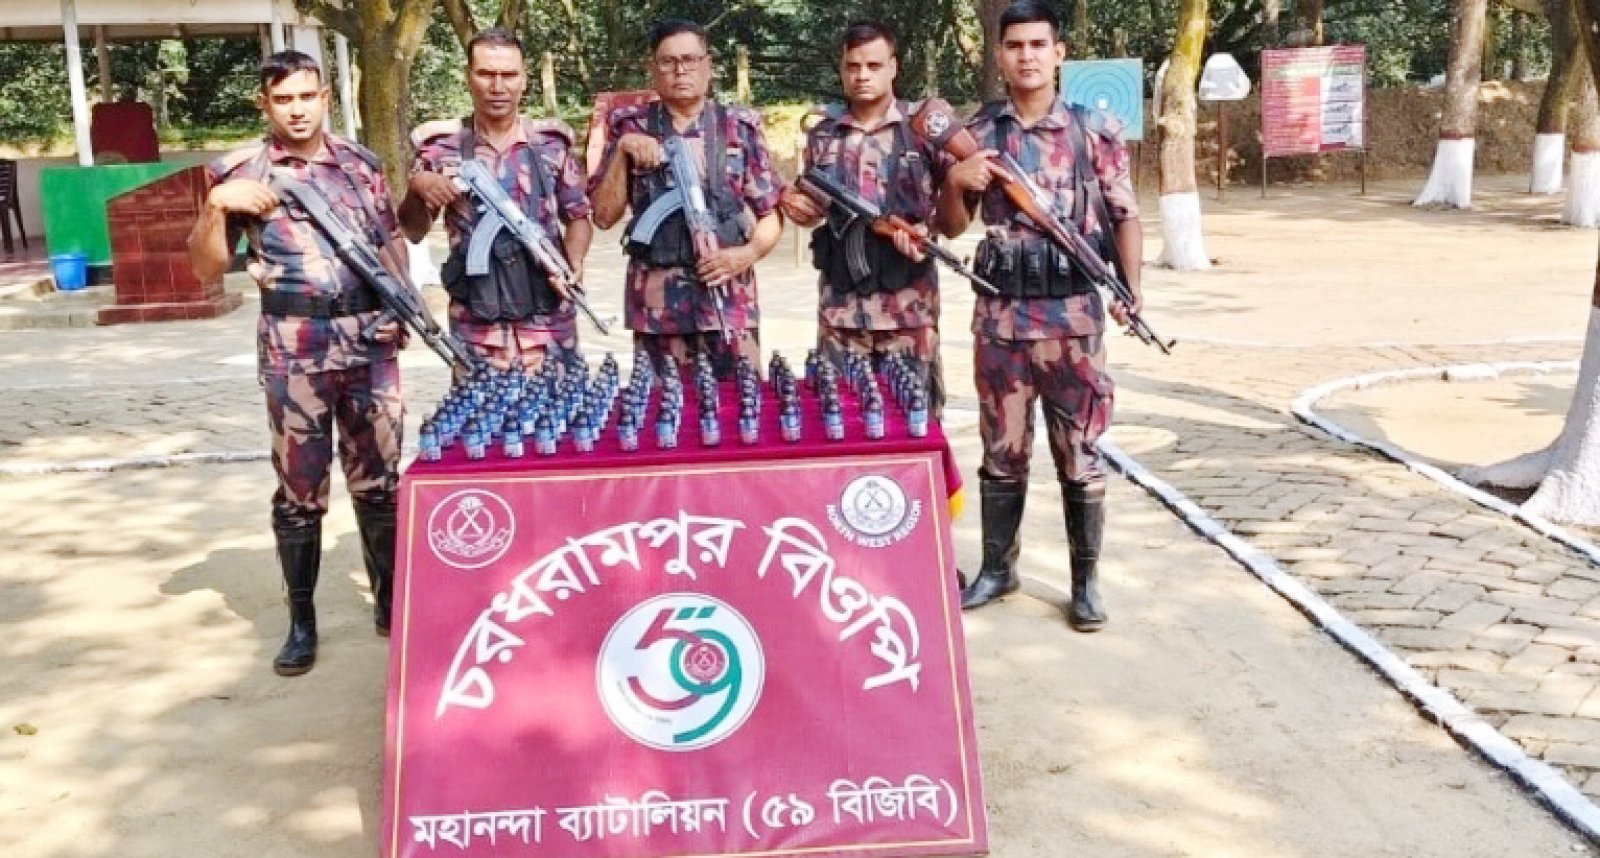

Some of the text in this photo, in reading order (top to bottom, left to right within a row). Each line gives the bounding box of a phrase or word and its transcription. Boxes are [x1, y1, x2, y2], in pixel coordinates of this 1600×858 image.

[825, 504, 855, 542] NORTH
[857, 533, 893, 549] WEST
[893, 499, 922, 542] REGION
[435, 509, 922, 719] চরধরামপুর বিওপি
[408, 774, 958, 850] মহানন্দা ব্যাটালিয়ন (৫৯ বিজিবি)
